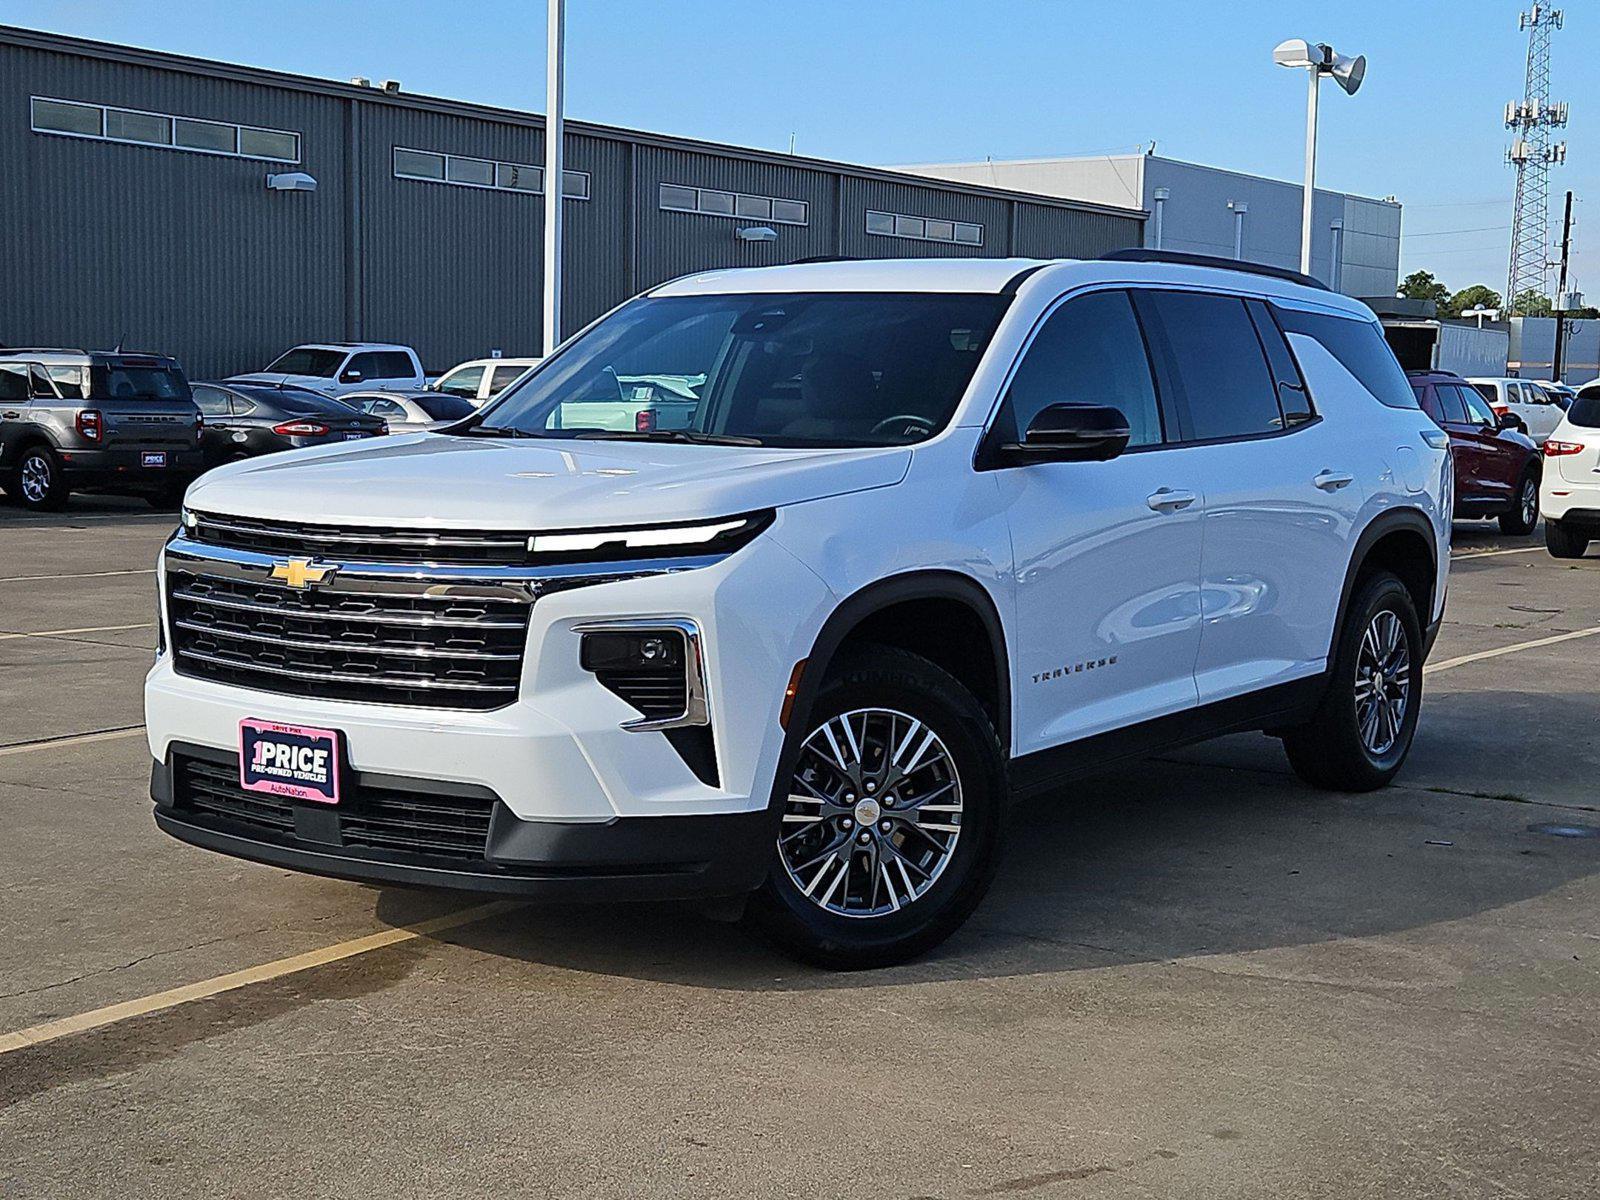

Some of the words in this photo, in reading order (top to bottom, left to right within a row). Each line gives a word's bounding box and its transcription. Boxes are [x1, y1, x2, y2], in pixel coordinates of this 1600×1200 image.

[1032, 655, 1118, 683] TRAVERSE
[251, 764, 292, 777] PRE-OWNED
[293, 770, 327, 783] VEHICLES
[270, 784, 308, 797] AutoNation
